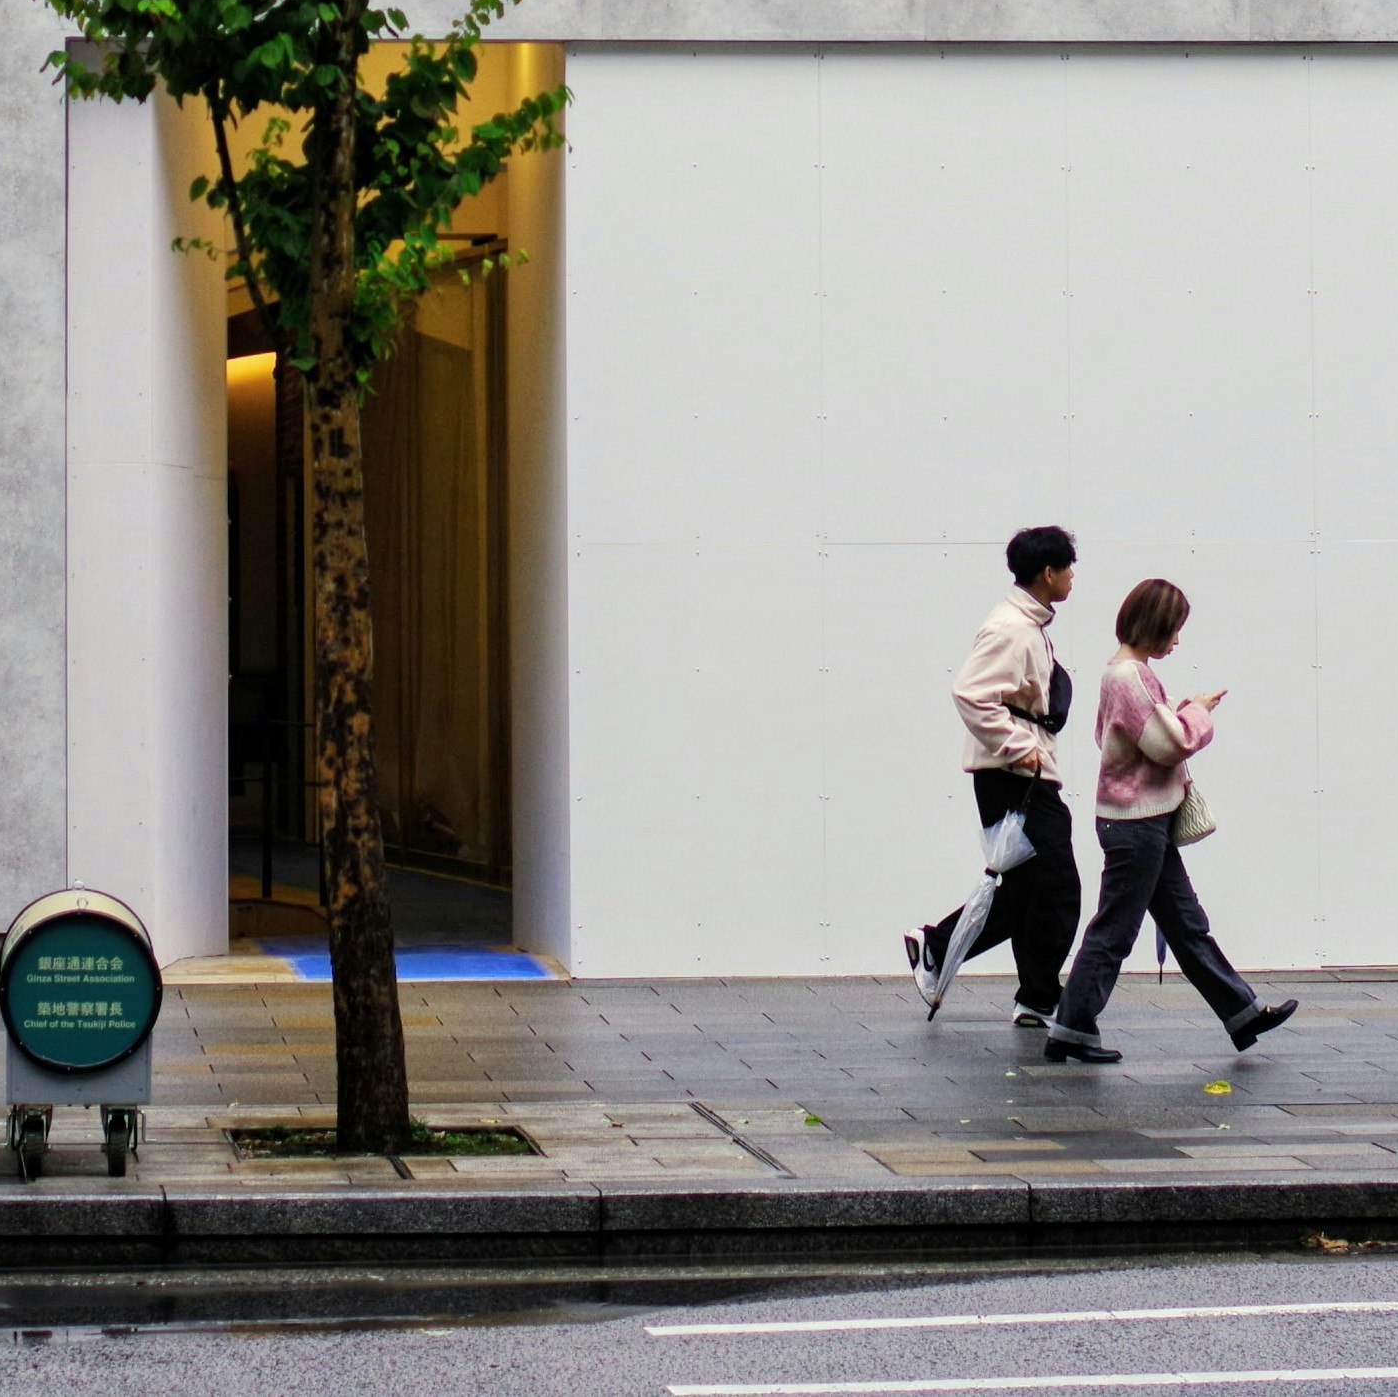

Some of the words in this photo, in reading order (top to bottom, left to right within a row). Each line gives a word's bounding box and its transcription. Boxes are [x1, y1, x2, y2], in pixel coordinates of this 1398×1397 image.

[38, 956, 123, 971] 銀座通連合会
[26, 974, 52, 983] Ginza
[54, 974, 80, 983] Street
[83, 974, 135, 983] Association
[37, 1002, 123, 1016] 築地警察署長
[23, 1020, 48, 1028] Chief
[49, 1020, 59, 1028] of
[60, 1020, 75, 1028] the
[78, 1020, 106, 1030] Tsukiji
[108, 1020, 136, 1028] Police
